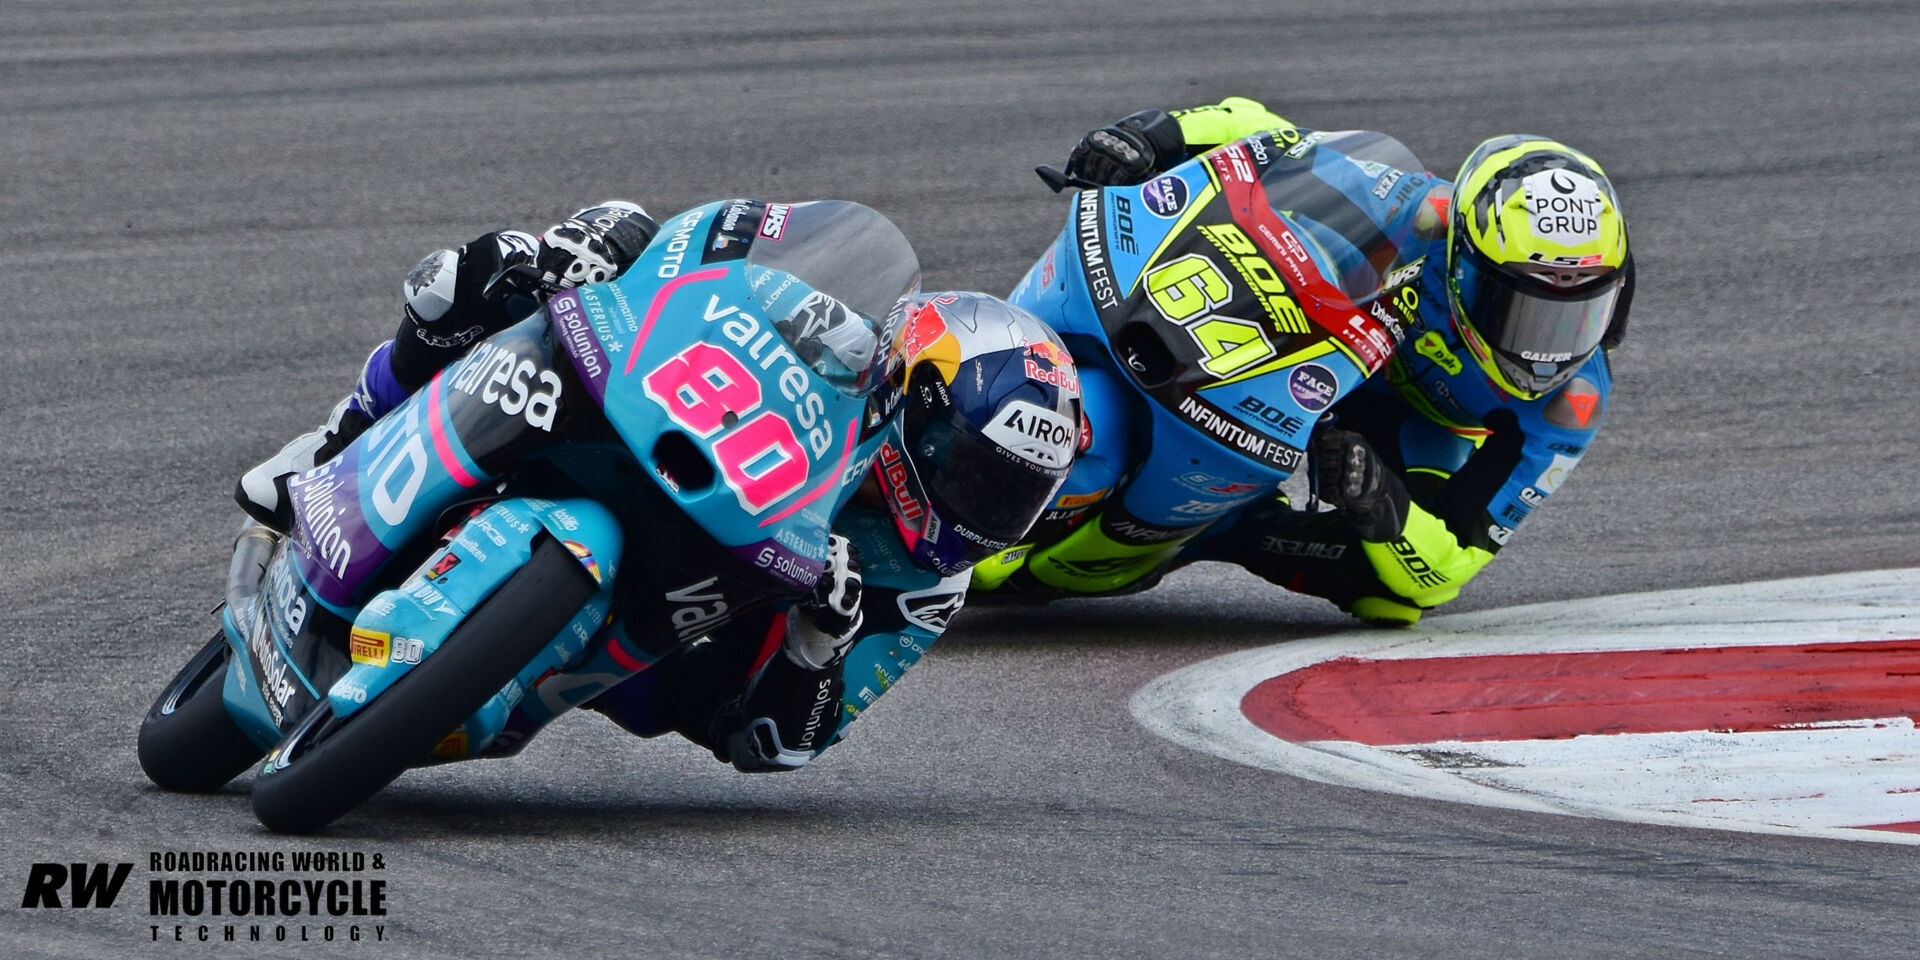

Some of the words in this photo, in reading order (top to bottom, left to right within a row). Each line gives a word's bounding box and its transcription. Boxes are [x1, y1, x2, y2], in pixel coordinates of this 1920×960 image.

[1223, 144, 1255, 183] S2
[1536, 197, 1595, 215] PONT
[1538, 216, 1598, 234] GRUP
[658, 211, 704, 279] CFMOTO
[1079, 189, 1105, 268] INFINITUM
[1528, 252, 1603, 267] LS2
[1090, 266, 1119, 309] FEST
[1143, 253, 1278, 380] 64
[564, 312, 602, 379] solunion
[1520, 350, 1572, 362] GALFER
[703, 294, 833, 461] valresa
[1023, 358, 1058, 386] Red
[1297, 371, 1335, 397] FACE
[935, 381, 951, 407] AIROH
[641, 339, 811, 517] 80
[1002, 408, 1073, 449] AIROH
[1178, 396, 1266, 457] INFINITUM
[1263, 442, 1304, 469] FEST
[995, 446, 1021, 464] GIVES
[1024, 462, 1041, 473] YOU
[886, 462, 924, 521] Bull
[303, 473, 351, 580] solunion
[773, 555, 819, 588] solunion
[390, 637, 425, 665] 80
[798, 677, 832, 752] solunion
